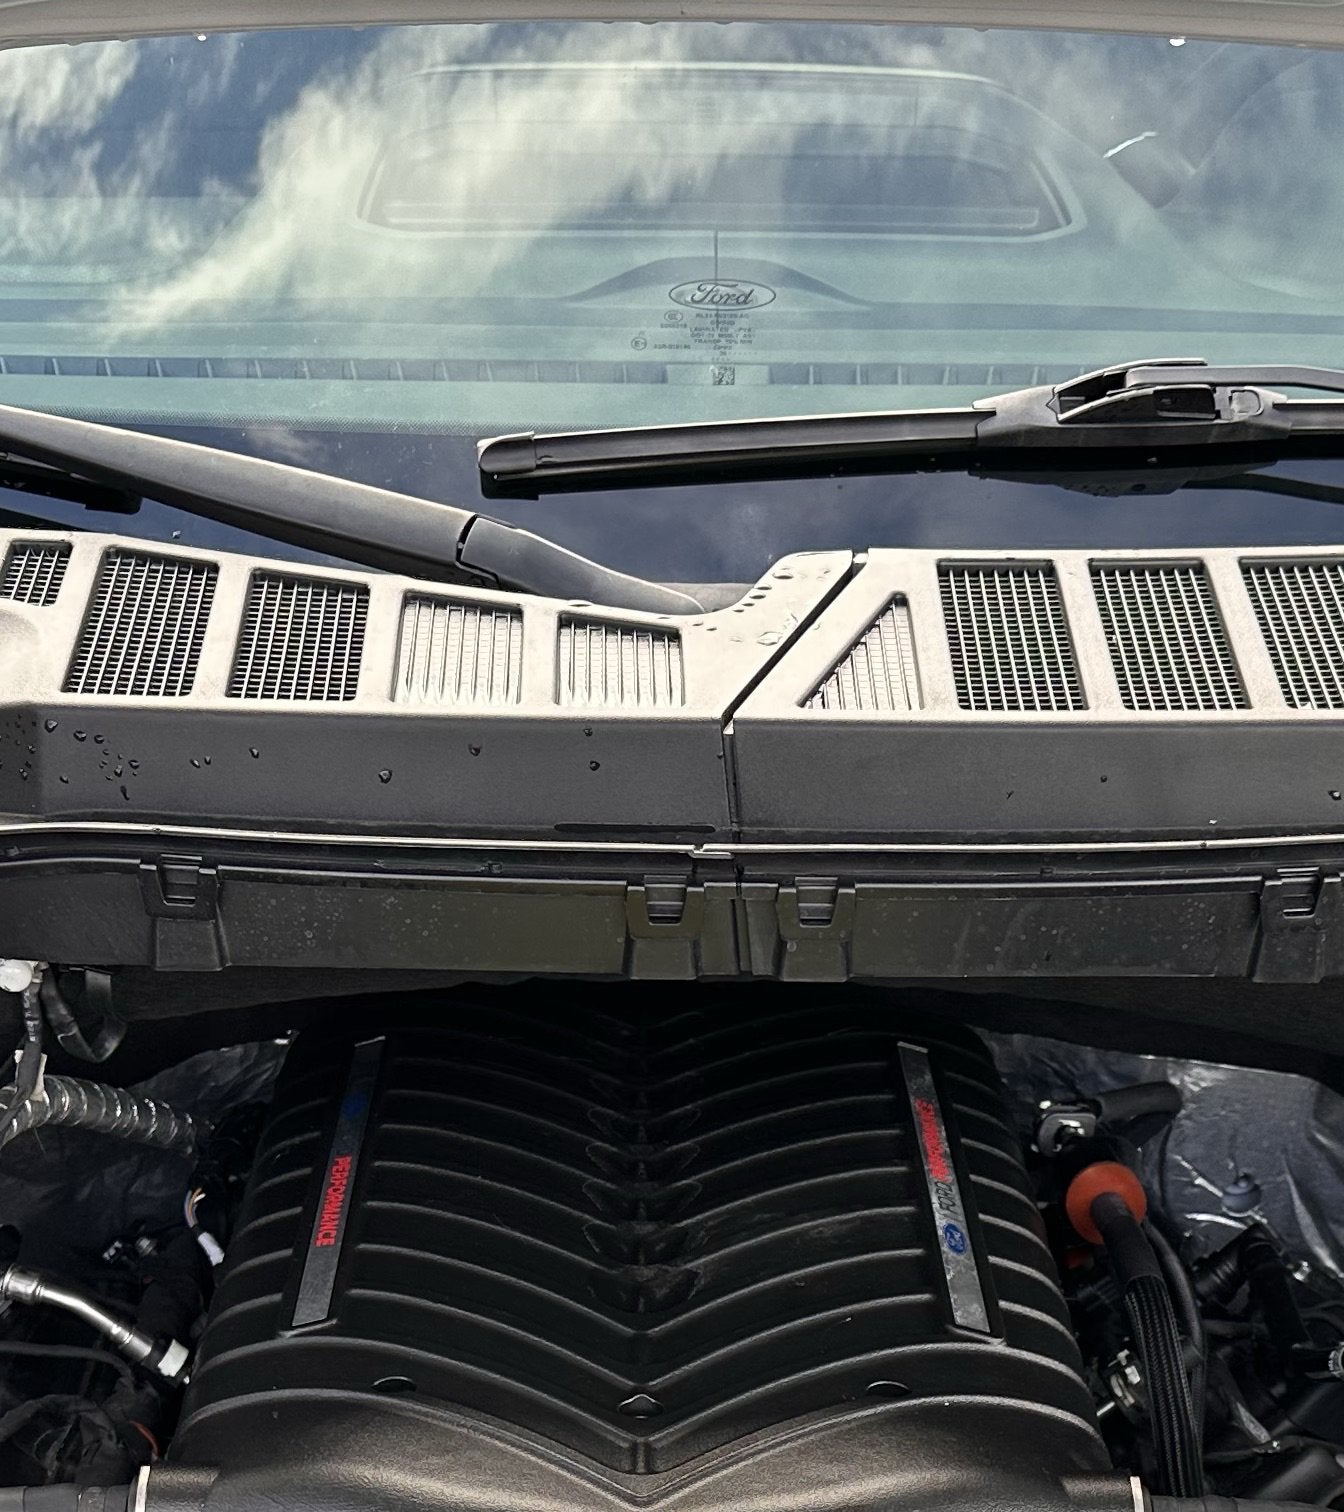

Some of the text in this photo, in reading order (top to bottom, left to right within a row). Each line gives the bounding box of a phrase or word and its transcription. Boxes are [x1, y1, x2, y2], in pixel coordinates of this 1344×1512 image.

[690, 282, 755, 305] Ford
[315, 1154, 353, 1248] PERFORMANCE
[934, 1181, 957, 1215] FORD
